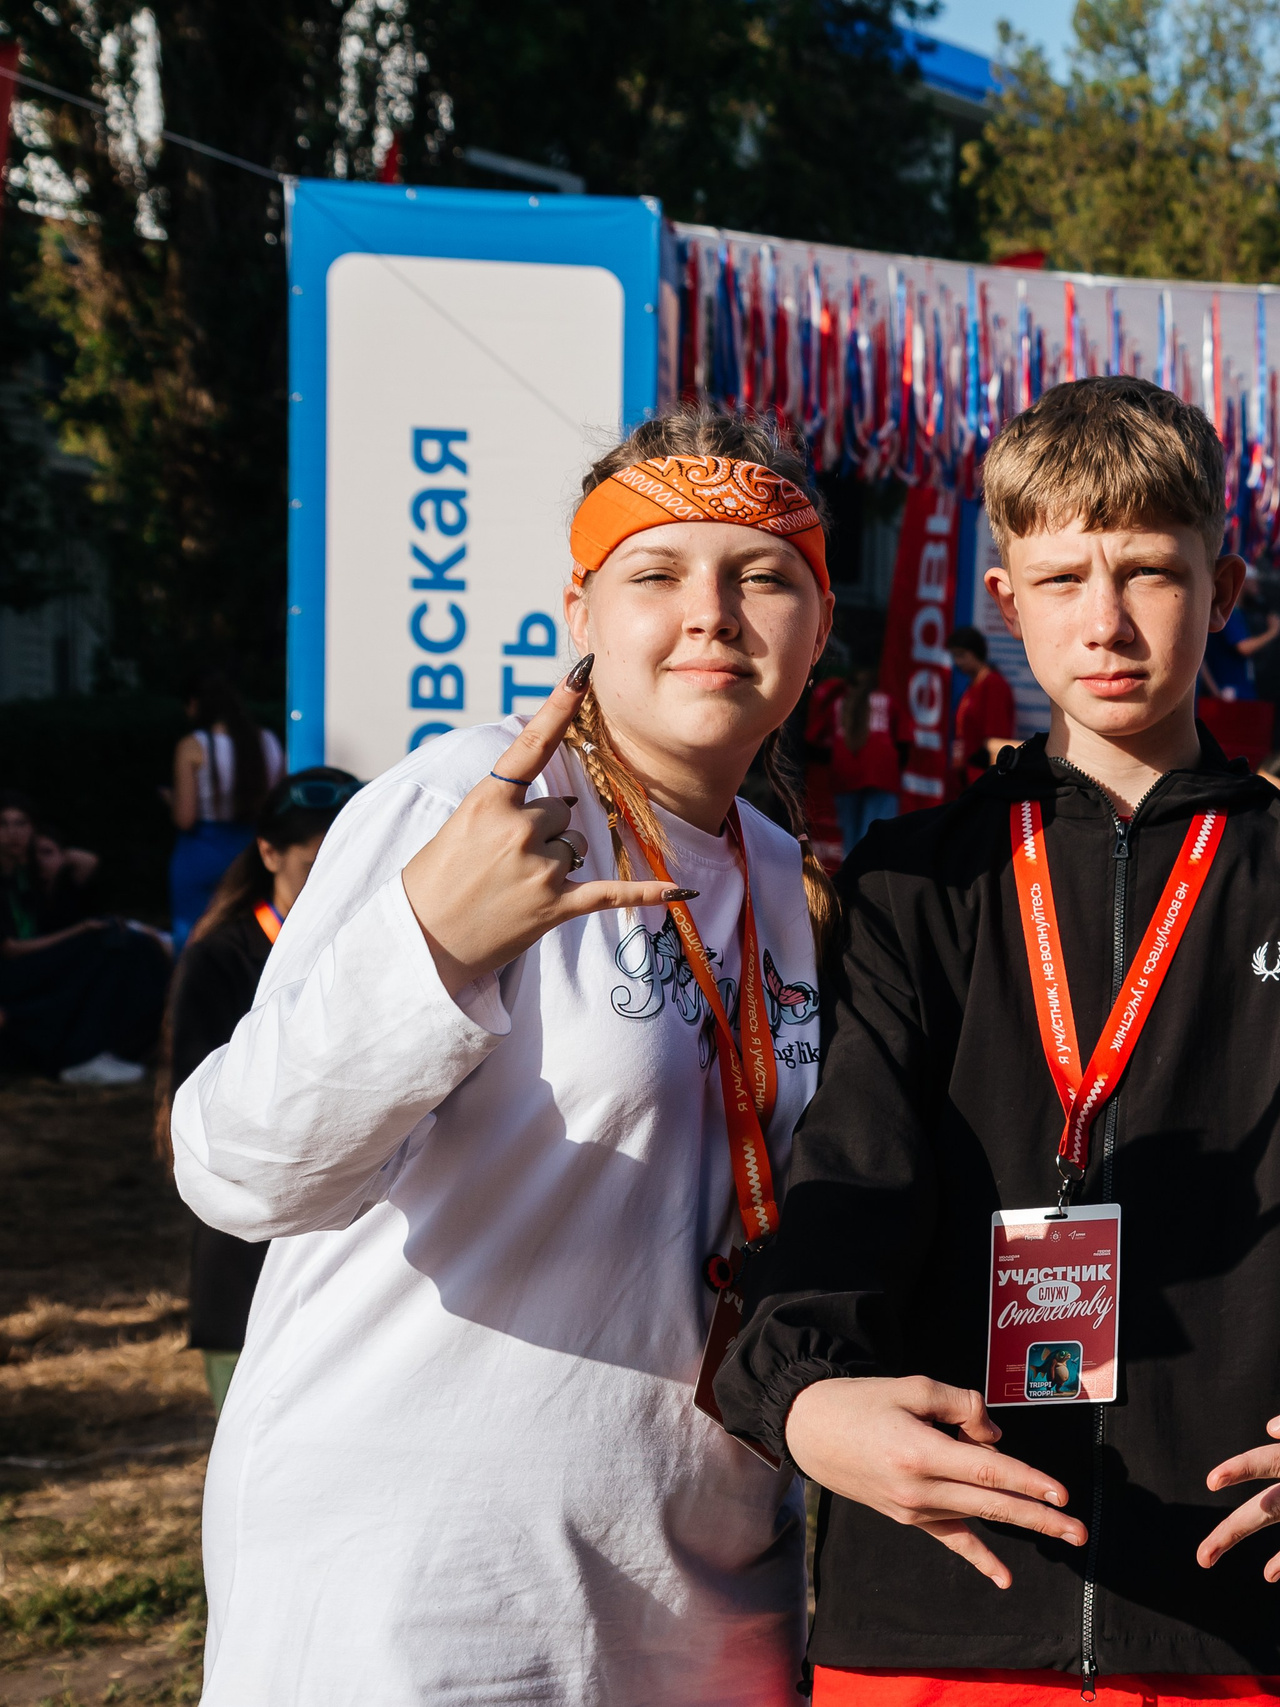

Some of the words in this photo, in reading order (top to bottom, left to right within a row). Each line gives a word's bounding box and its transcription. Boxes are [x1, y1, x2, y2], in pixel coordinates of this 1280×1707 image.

[1175, 882, 1190, 900] не
[1030, 882, 1052, 961] волнуйтесь
[1143, 898, 1183, 975] волнуйтесь
[1043, 962, 1054, 980] не
[997, 1263, 1112, 1287] УЧАСТНИК
[1029, 1381, 1052, 1389] TRIPPI
